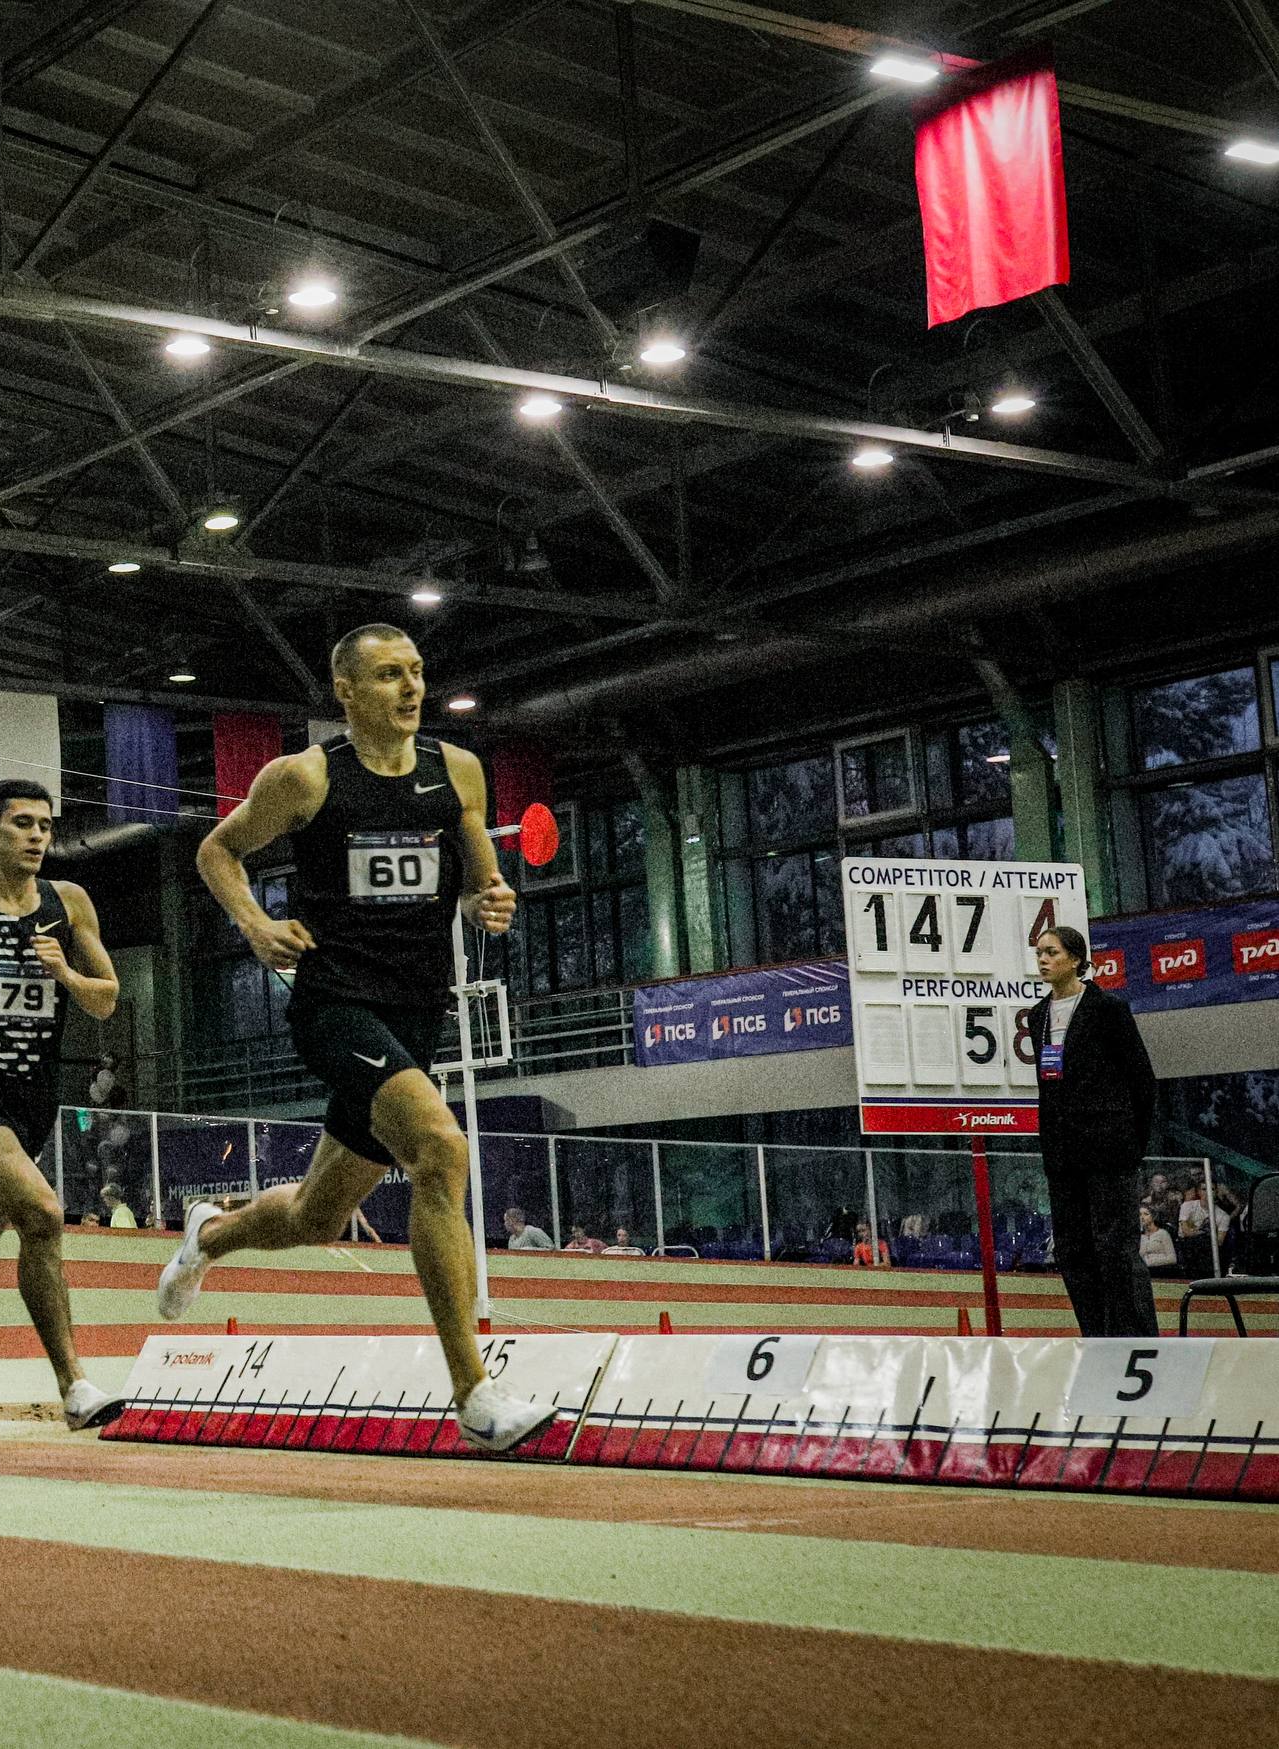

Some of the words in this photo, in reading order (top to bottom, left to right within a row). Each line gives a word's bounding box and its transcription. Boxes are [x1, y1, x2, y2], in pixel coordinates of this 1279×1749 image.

[368, 854, 422, 887] 60
[849, 866, 973, 888] COMPETITOR
[978, 870, 986, 888] /
[992, 871, 1078, 890] ATTEMPT
[1, 983, 44, 1011] 79
[902, 978, 1044, 999] PERFORMANCE
[733, 1014, 767, 1034] ПСБ
[805, 1005, 841, 1026] ПСБ
[664, 1022, 696, 1042] ПСБ
[970, 1112, 1016, 1128] polanik
[170, 1352, 215, 1368] polanik
[238, 1340, 274, 1379] 14
[481, 1339, 516, 1380] 15
[747, 1336, 781, 1381] 6
[1116, 1349, 1159, 1402] 5
